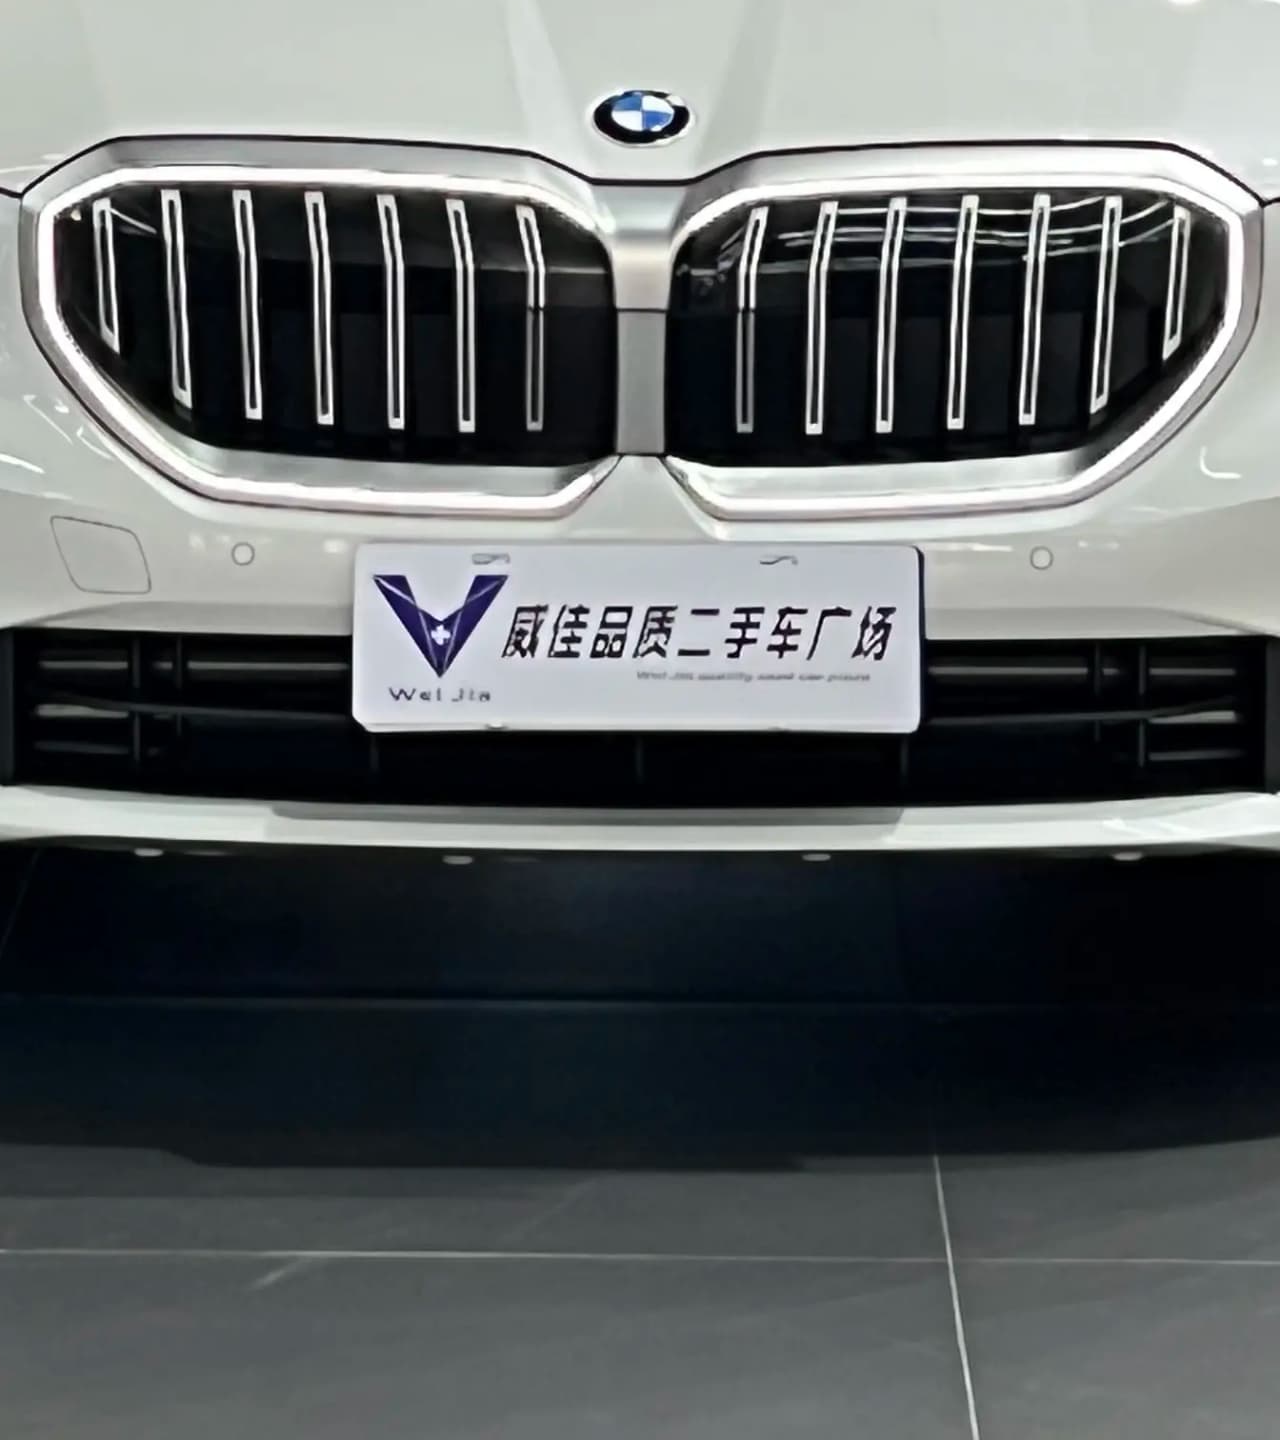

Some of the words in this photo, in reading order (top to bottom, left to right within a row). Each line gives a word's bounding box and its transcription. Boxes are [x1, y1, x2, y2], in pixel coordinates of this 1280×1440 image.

[501, 603, 897, 661] 威佳品质二手车广场
